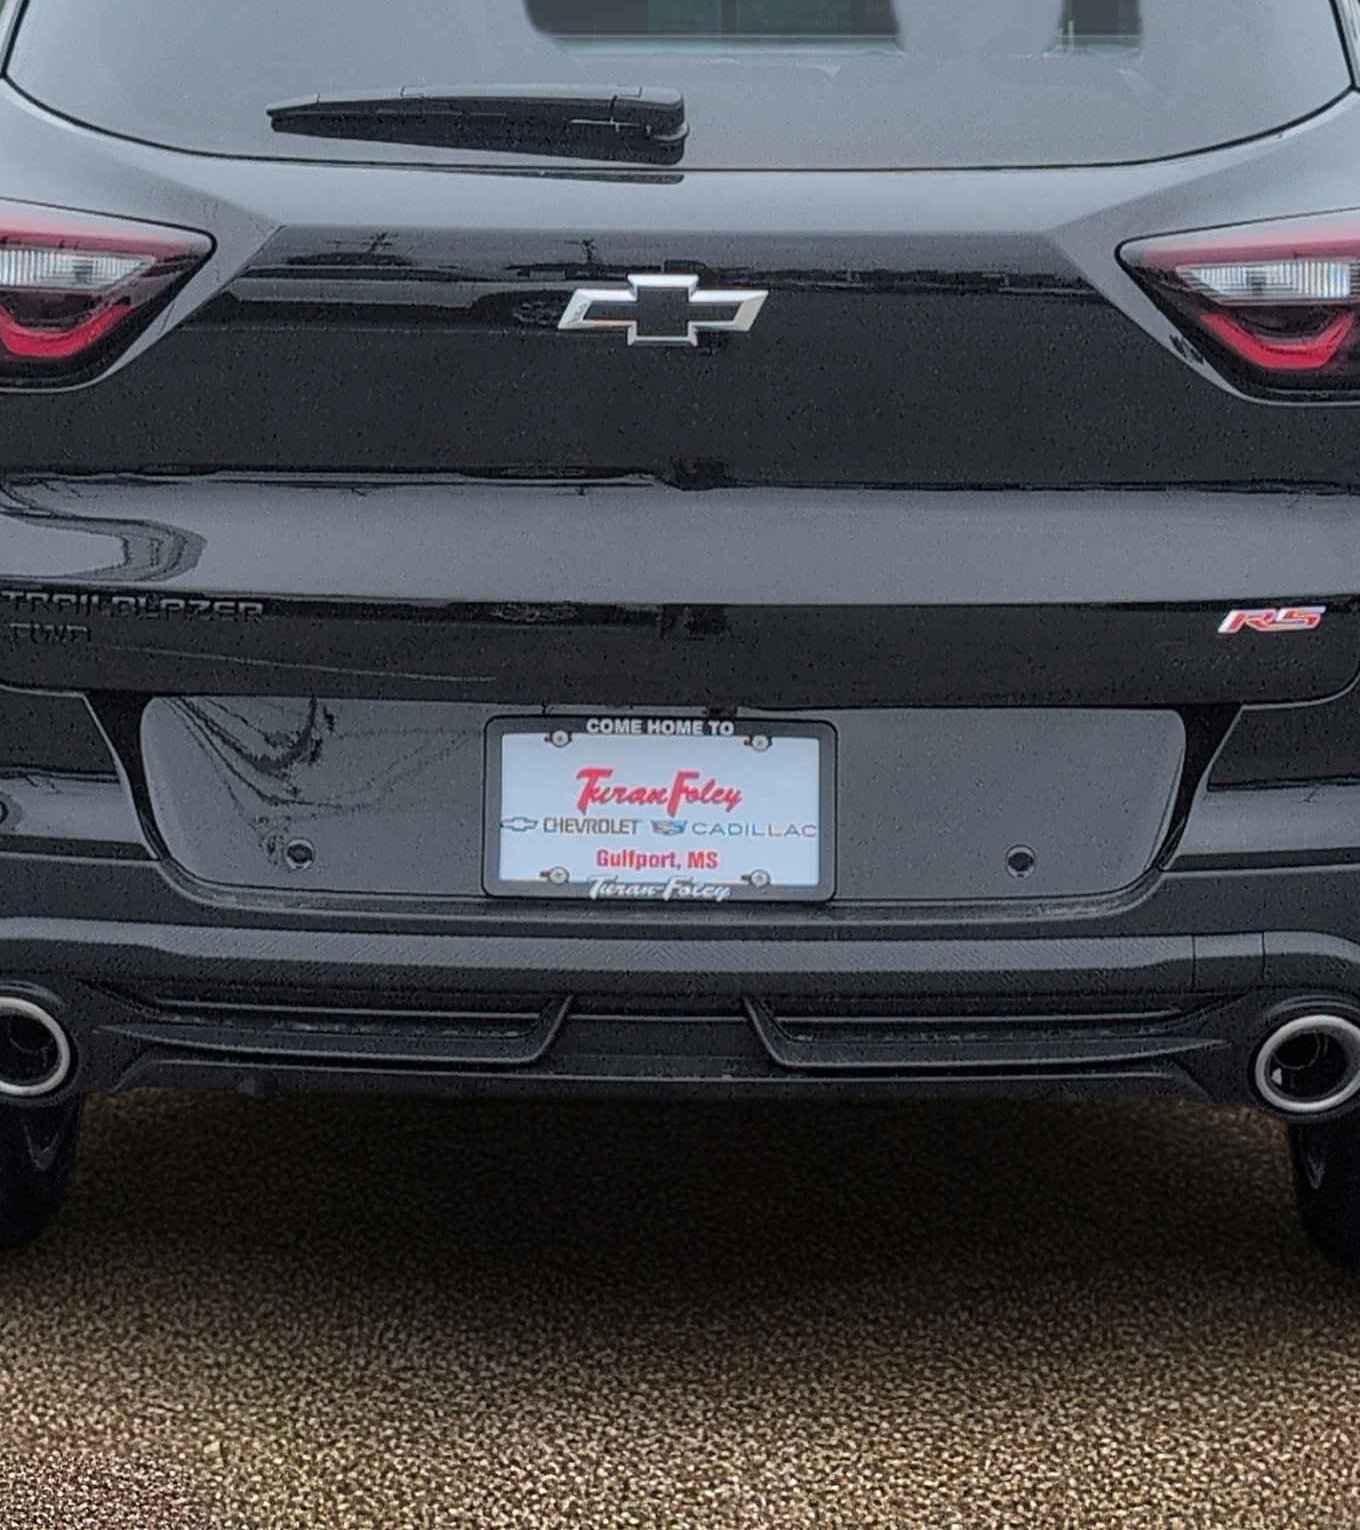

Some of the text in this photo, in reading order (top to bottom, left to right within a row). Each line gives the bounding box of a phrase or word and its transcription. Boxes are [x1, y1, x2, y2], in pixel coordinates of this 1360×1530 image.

[1217, 605, 1327, 634] RS
[586, 718, 735, 737] COME HOME TO
[542, 816, 818, 838] CHEVROLET CADILLAC
[596, 848, 719, 871] Gulfport, MS
